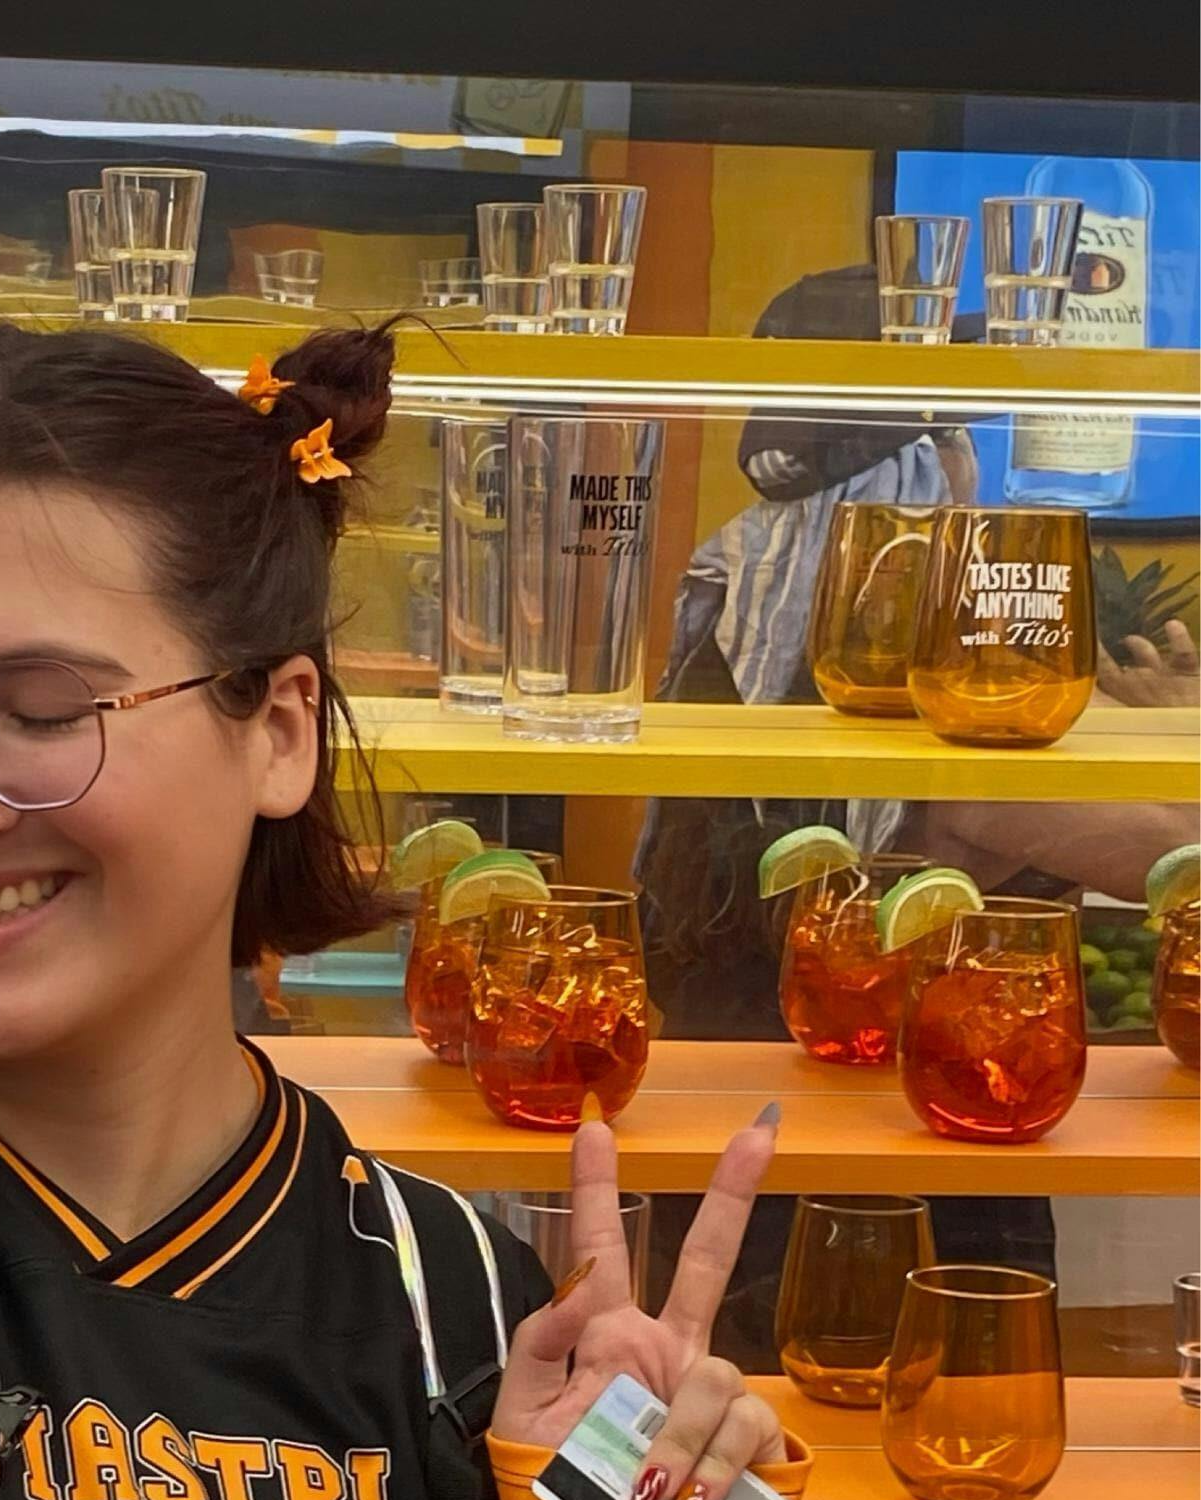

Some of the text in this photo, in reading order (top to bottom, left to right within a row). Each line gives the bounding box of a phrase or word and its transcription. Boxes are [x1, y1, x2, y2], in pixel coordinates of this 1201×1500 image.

[569, 474, 652, 501] MADE THIS
[582, 505, 643, 530] MYSELF
[968, 562, 1073, 592] TASTES LIKE
[973, 591, 1065, 621] ANYTHING
[960, 620, 1074, 648] with Tito's
